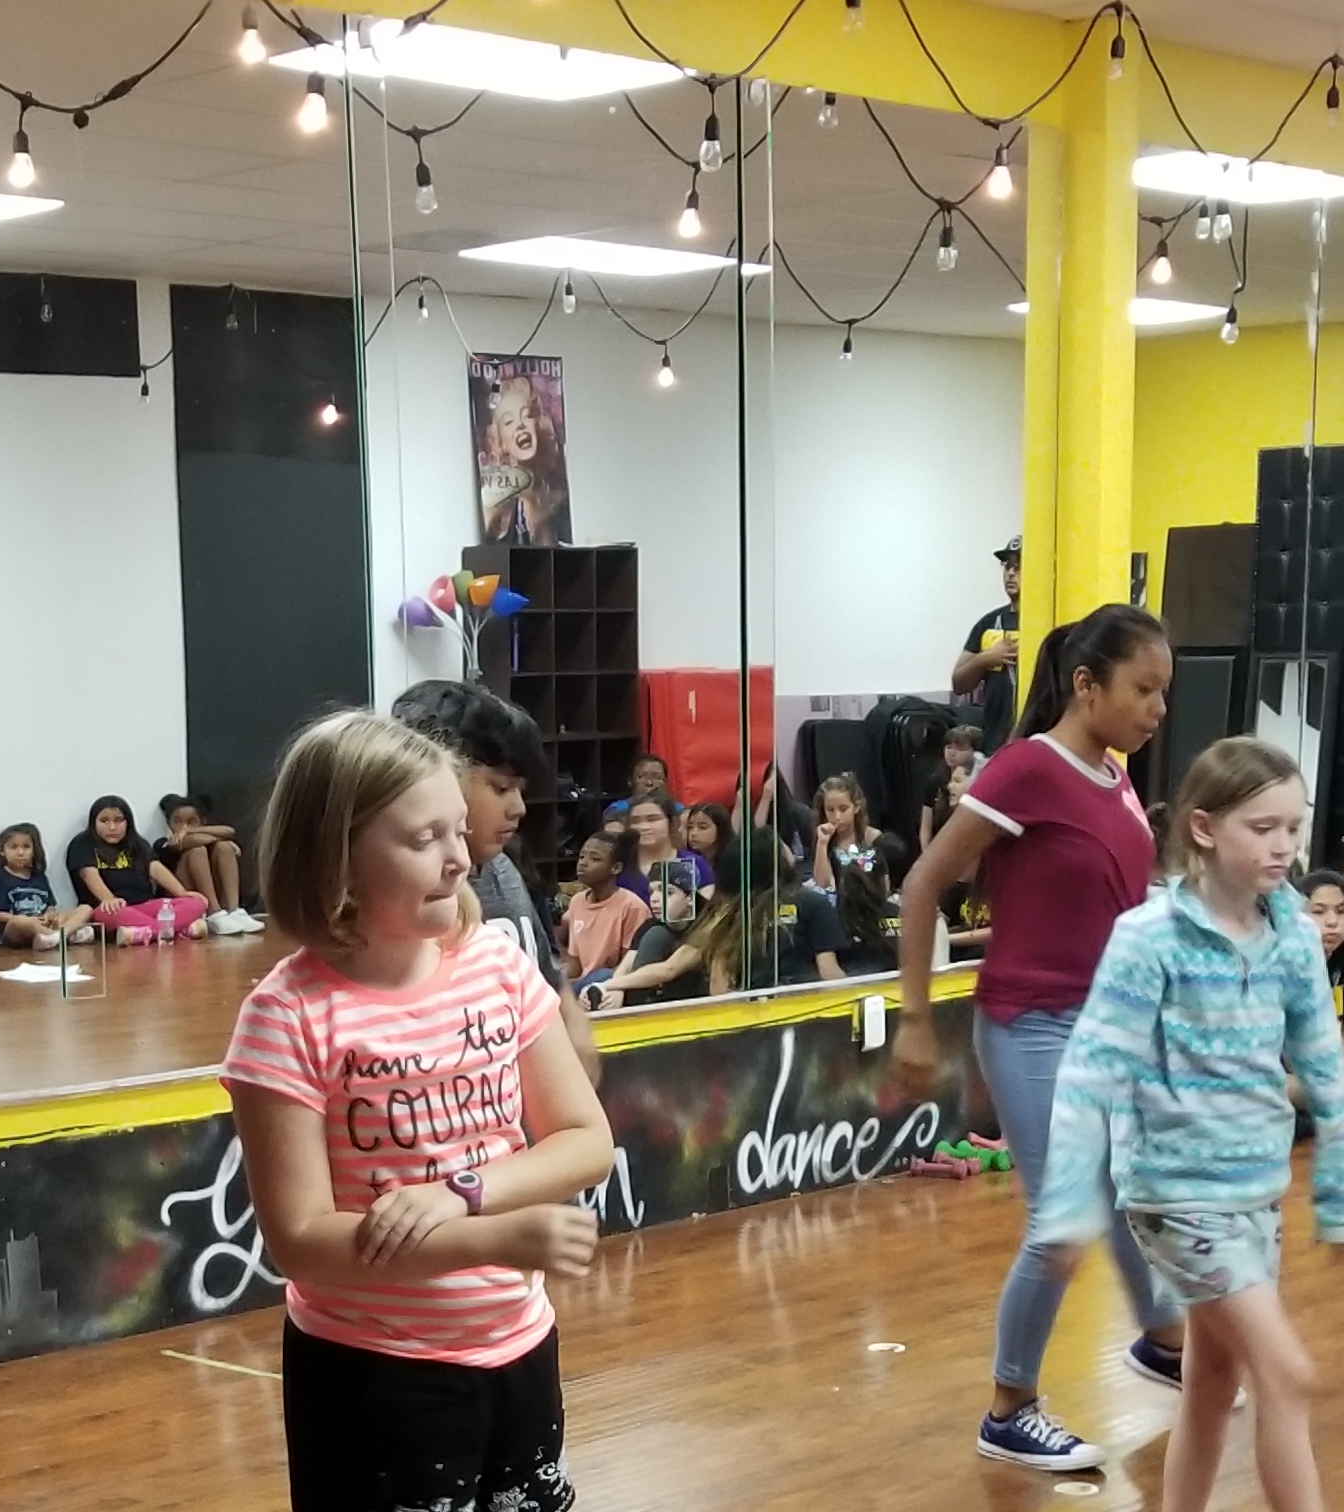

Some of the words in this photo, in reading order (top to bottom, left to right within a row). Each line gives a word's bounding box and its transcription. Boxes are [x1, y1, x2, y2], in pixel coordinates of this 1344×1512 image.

[342, 1049, 444, 1093] have
[454, 1004, 517, 1068] the
[347, 1058, 521, 1152] COURAG
